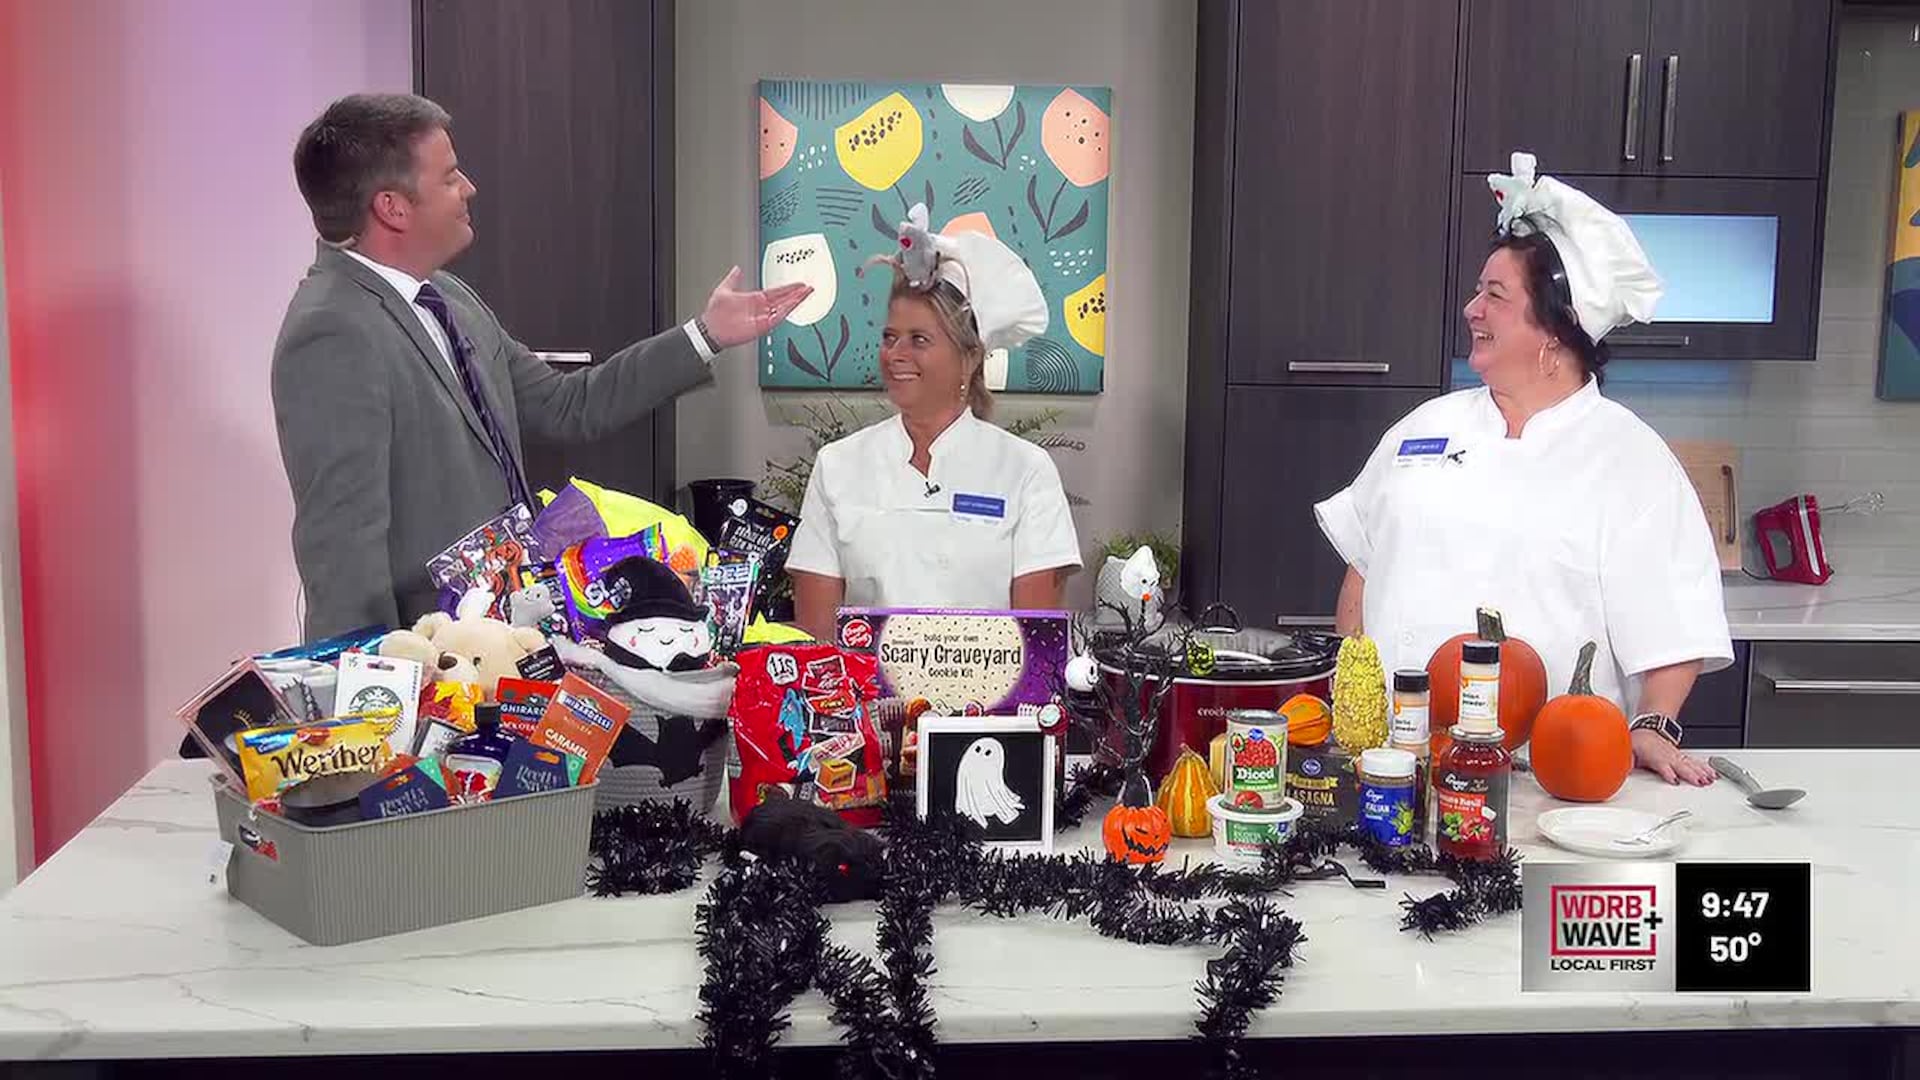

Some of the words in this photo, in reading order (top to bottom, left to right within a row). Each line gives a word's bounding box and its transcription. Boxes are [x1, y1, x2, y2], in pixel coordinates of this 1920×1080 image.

[946, 634, 963, 643] your
[881, 643, 928, 668] Scary
[934, 645, 1021, 670] Graveyard
[928, 667, 959, 677] Cookie
[961, 667, 973, 678] Kit
[500, 703, 546, 716] GHIRARD
[544, 727, 589, 759] CARAMEL
[1237, 768, 1274, 780] Diced
